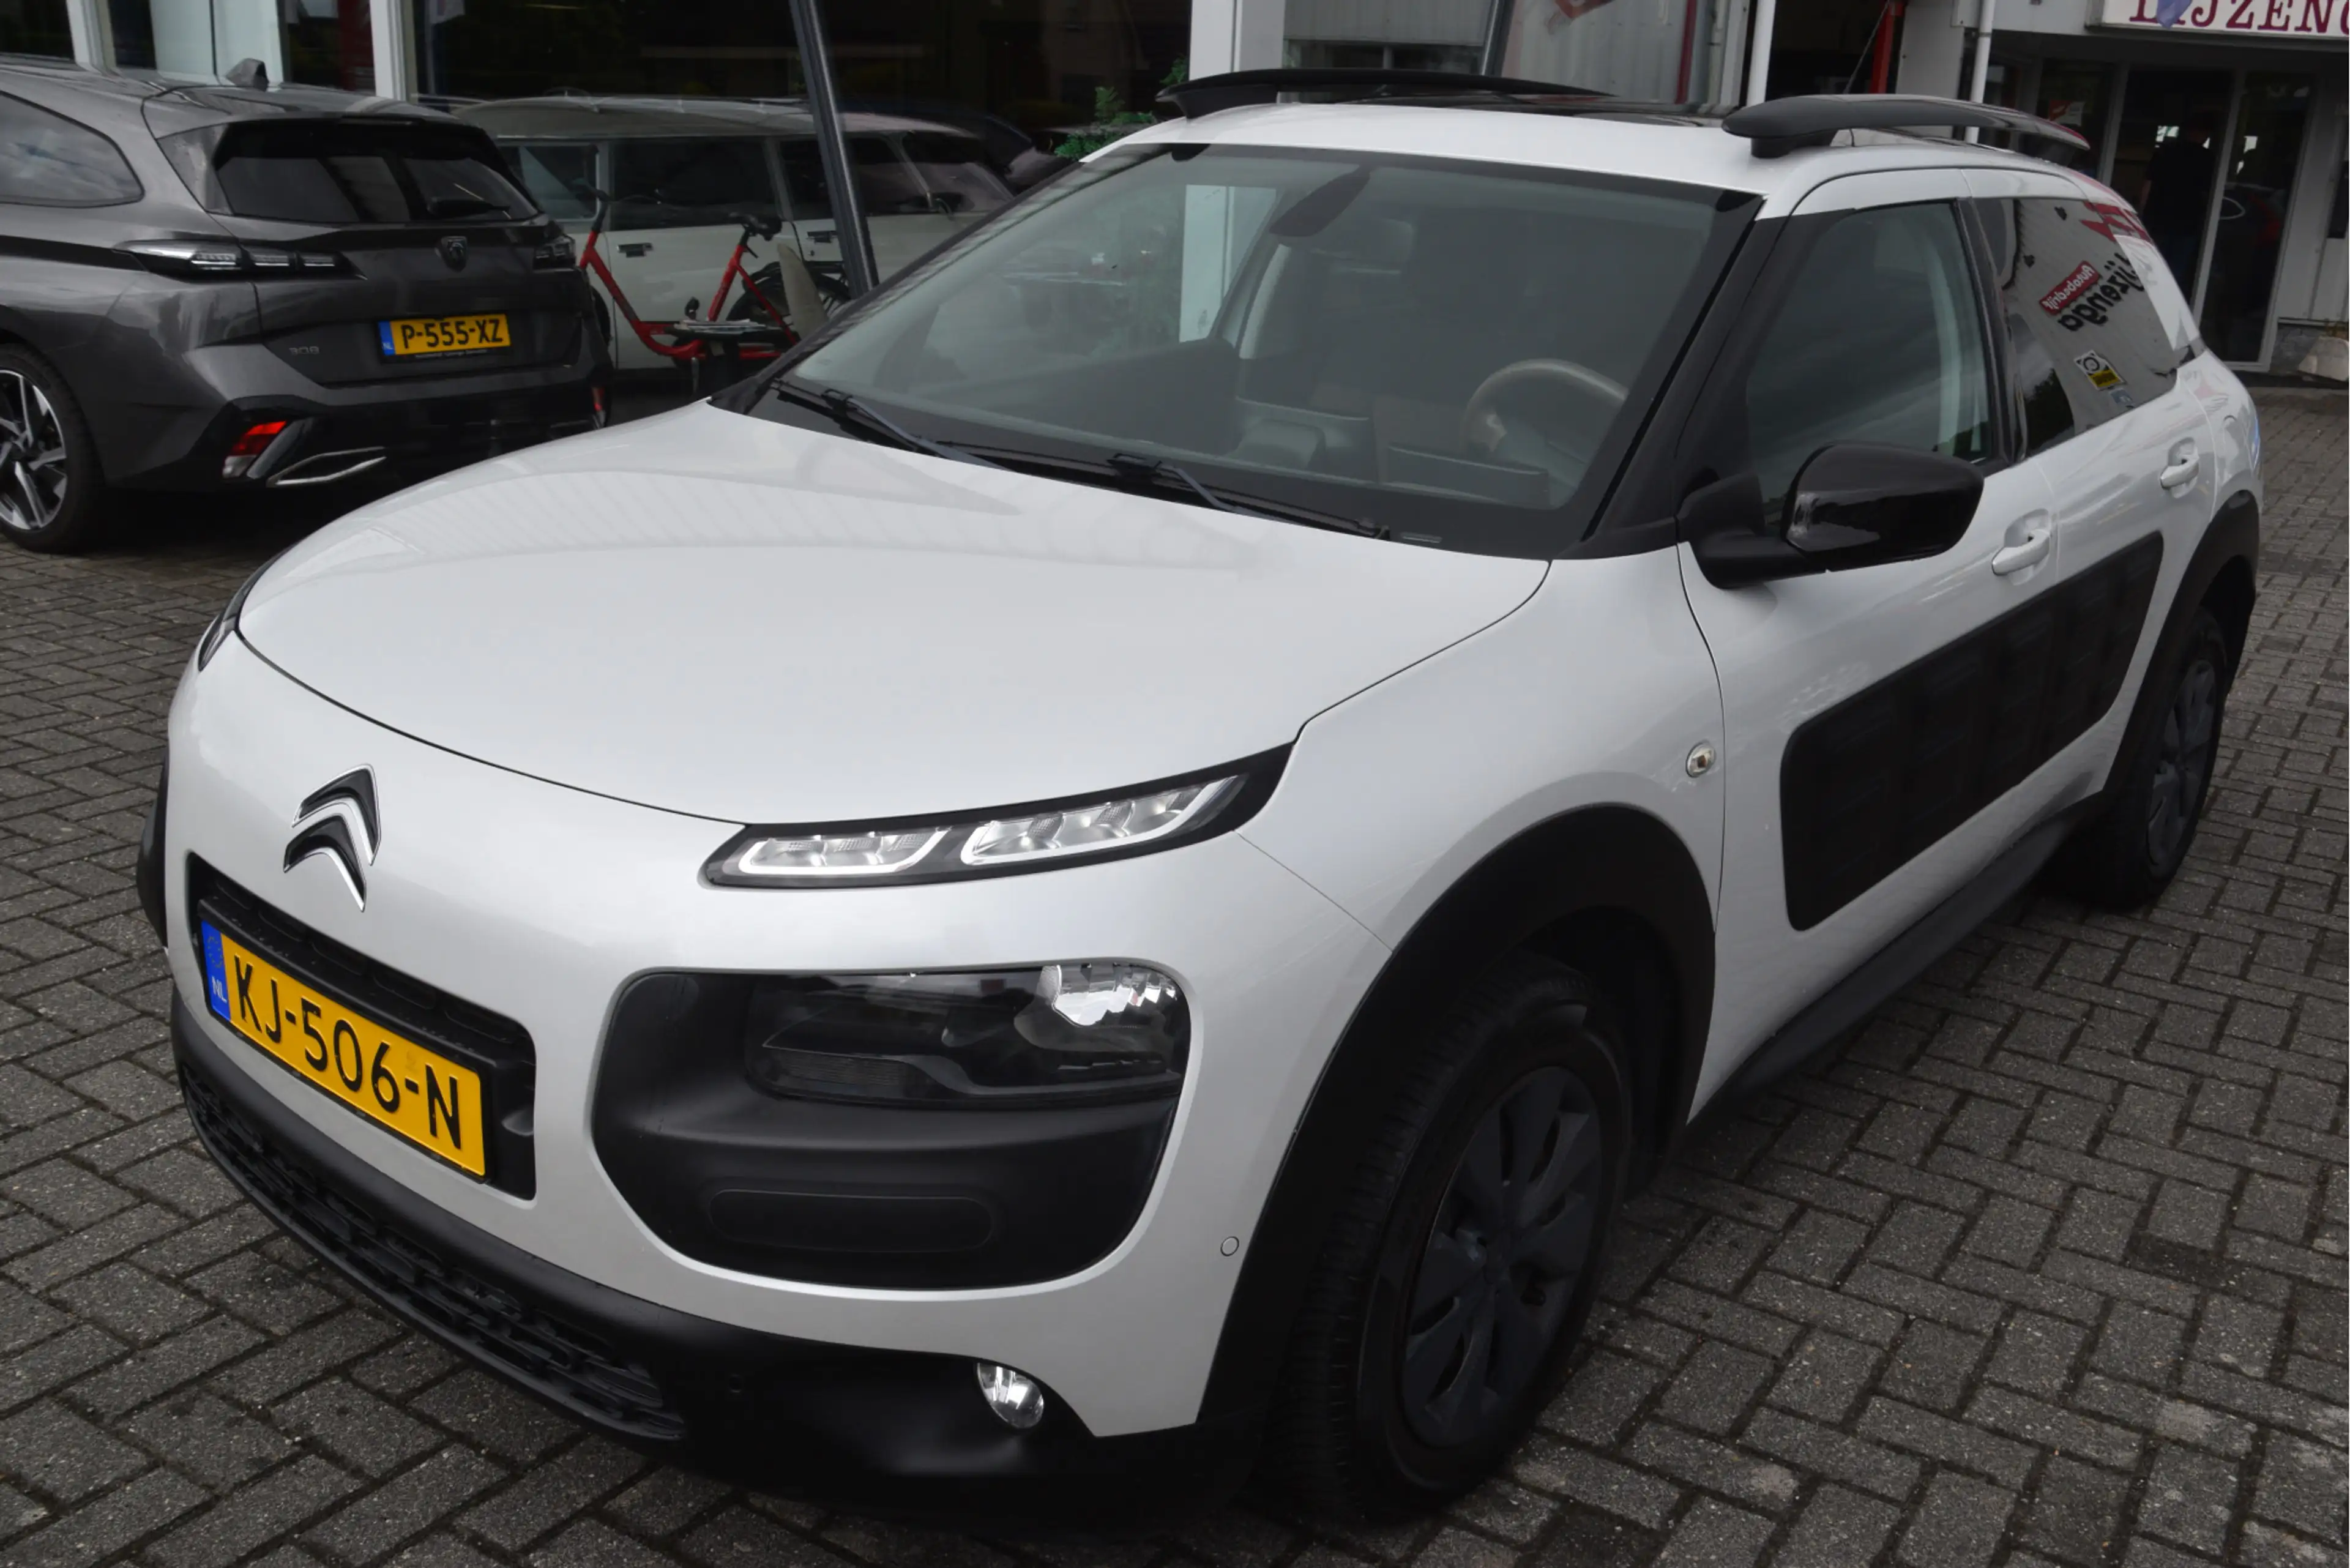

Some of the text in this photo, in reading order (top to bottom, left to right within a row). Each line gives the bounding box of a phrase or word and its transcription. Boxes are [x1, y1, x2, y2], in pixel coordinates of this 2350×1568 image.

[2129, 0, 2349, 35] LJZEN
[382, 319, 504, 350] NL P-555-XZ
[212, 953, 462, 1151] NL KJ-506-N
